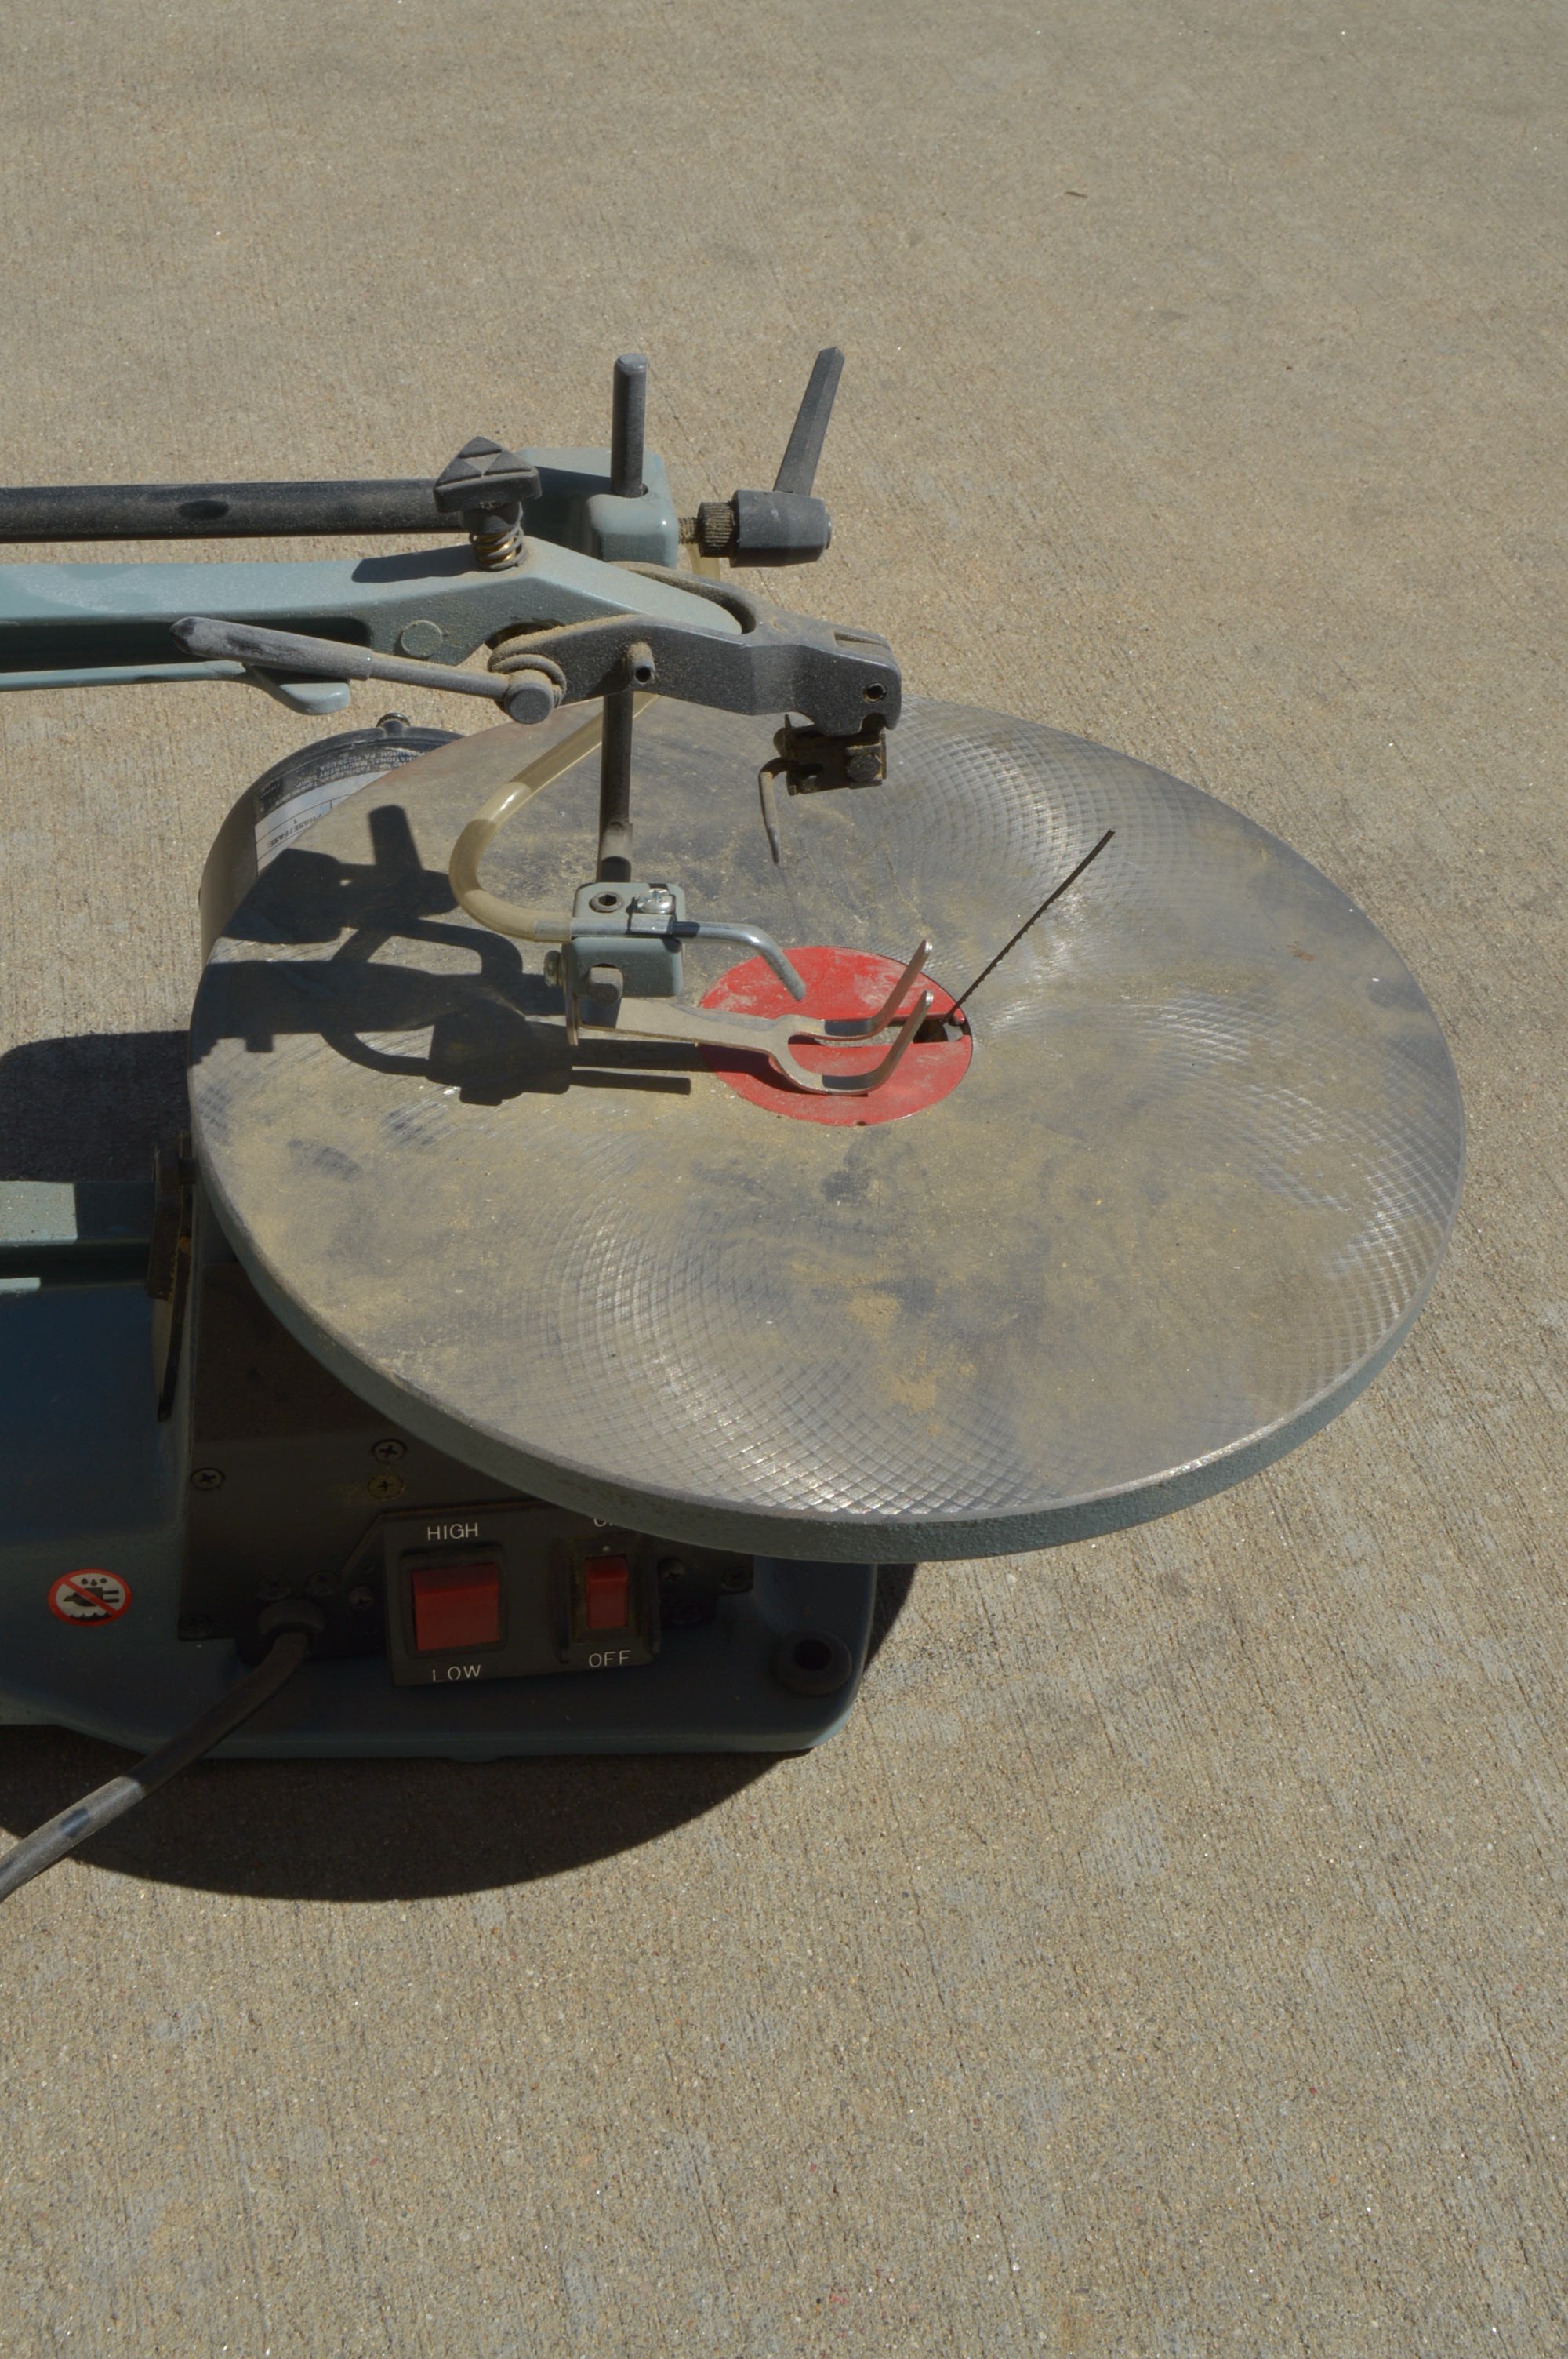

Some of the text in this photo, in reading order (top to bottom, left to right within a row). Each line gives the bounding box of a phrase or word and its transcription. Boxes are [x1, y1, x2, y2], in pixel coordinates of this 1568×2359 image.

[427, 1522, 479, 1541] HIGH
[588, 1650, 631, 1668] OFF
[432, 1664, 481, 1683] LOW
